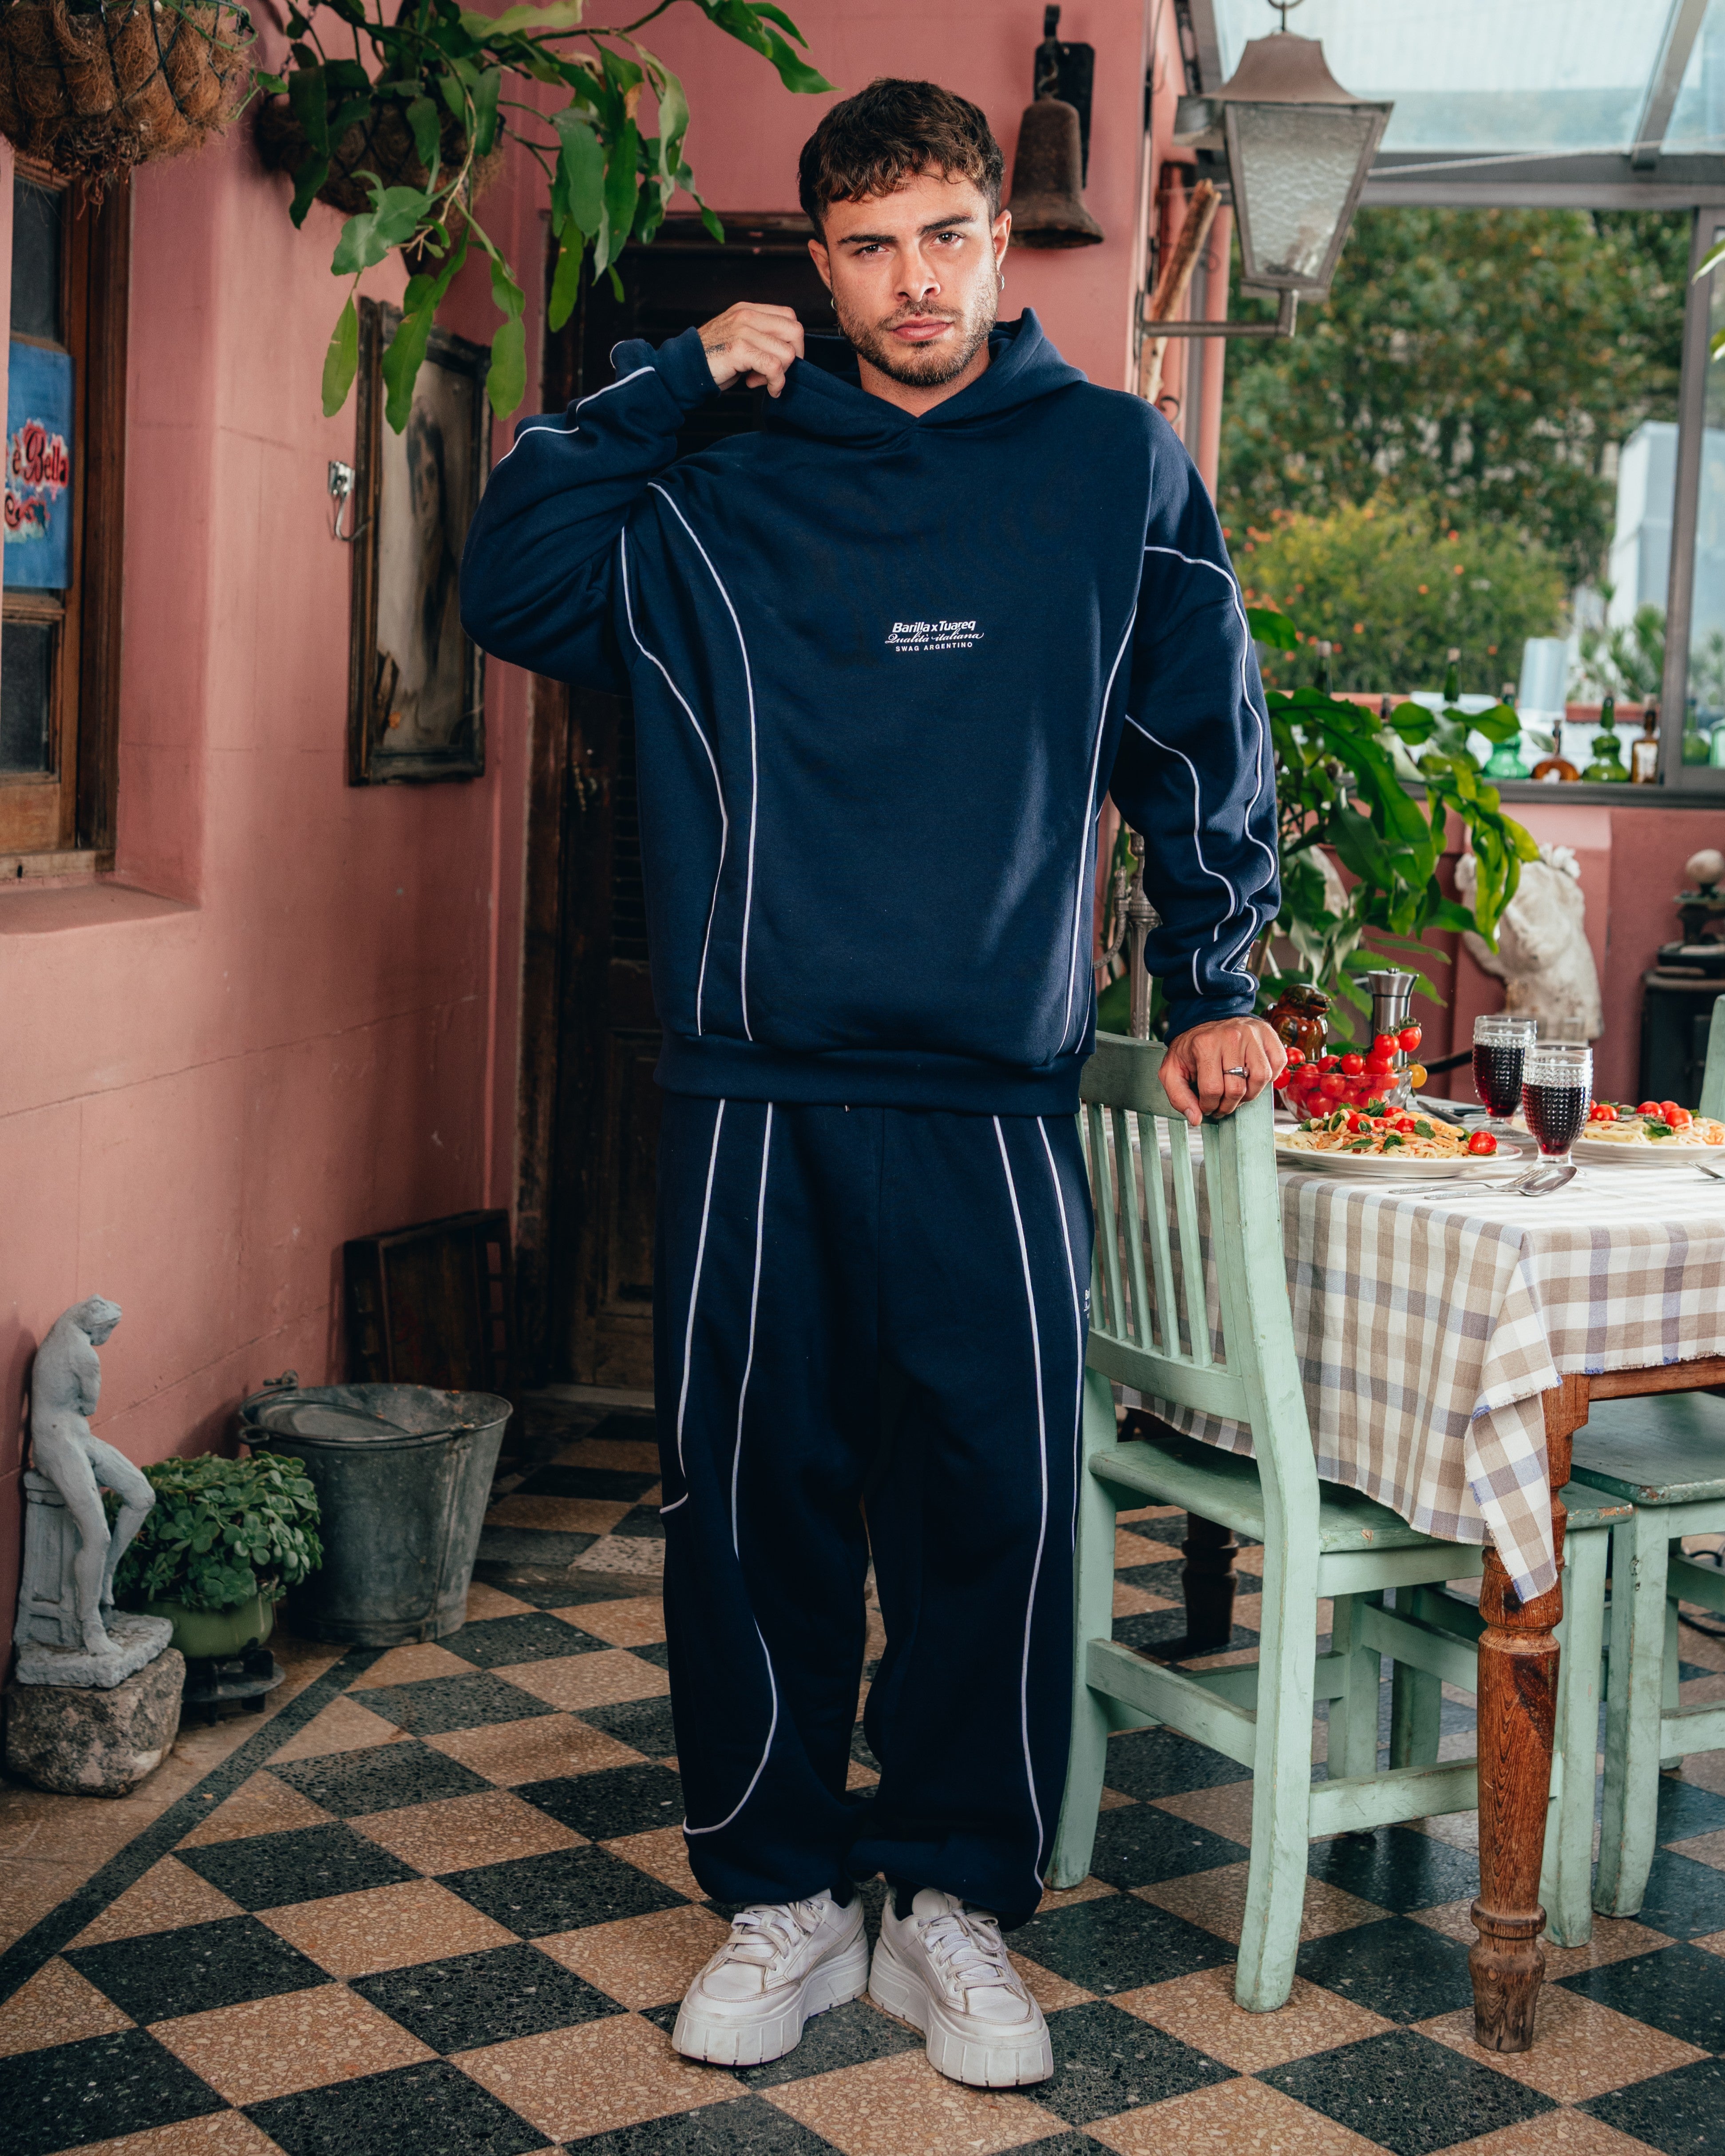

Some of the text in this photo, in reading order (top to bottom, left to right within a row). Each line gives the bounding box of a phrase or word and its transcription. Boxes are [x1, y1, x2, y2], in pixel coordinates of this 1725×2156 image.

[24, 425, 68, 483] Bella
[892, 622, 930, 633] Barilla
[885, 628, 984, 644] Qualità italiana
[924, 642, 973, 651] ARGENTINO
